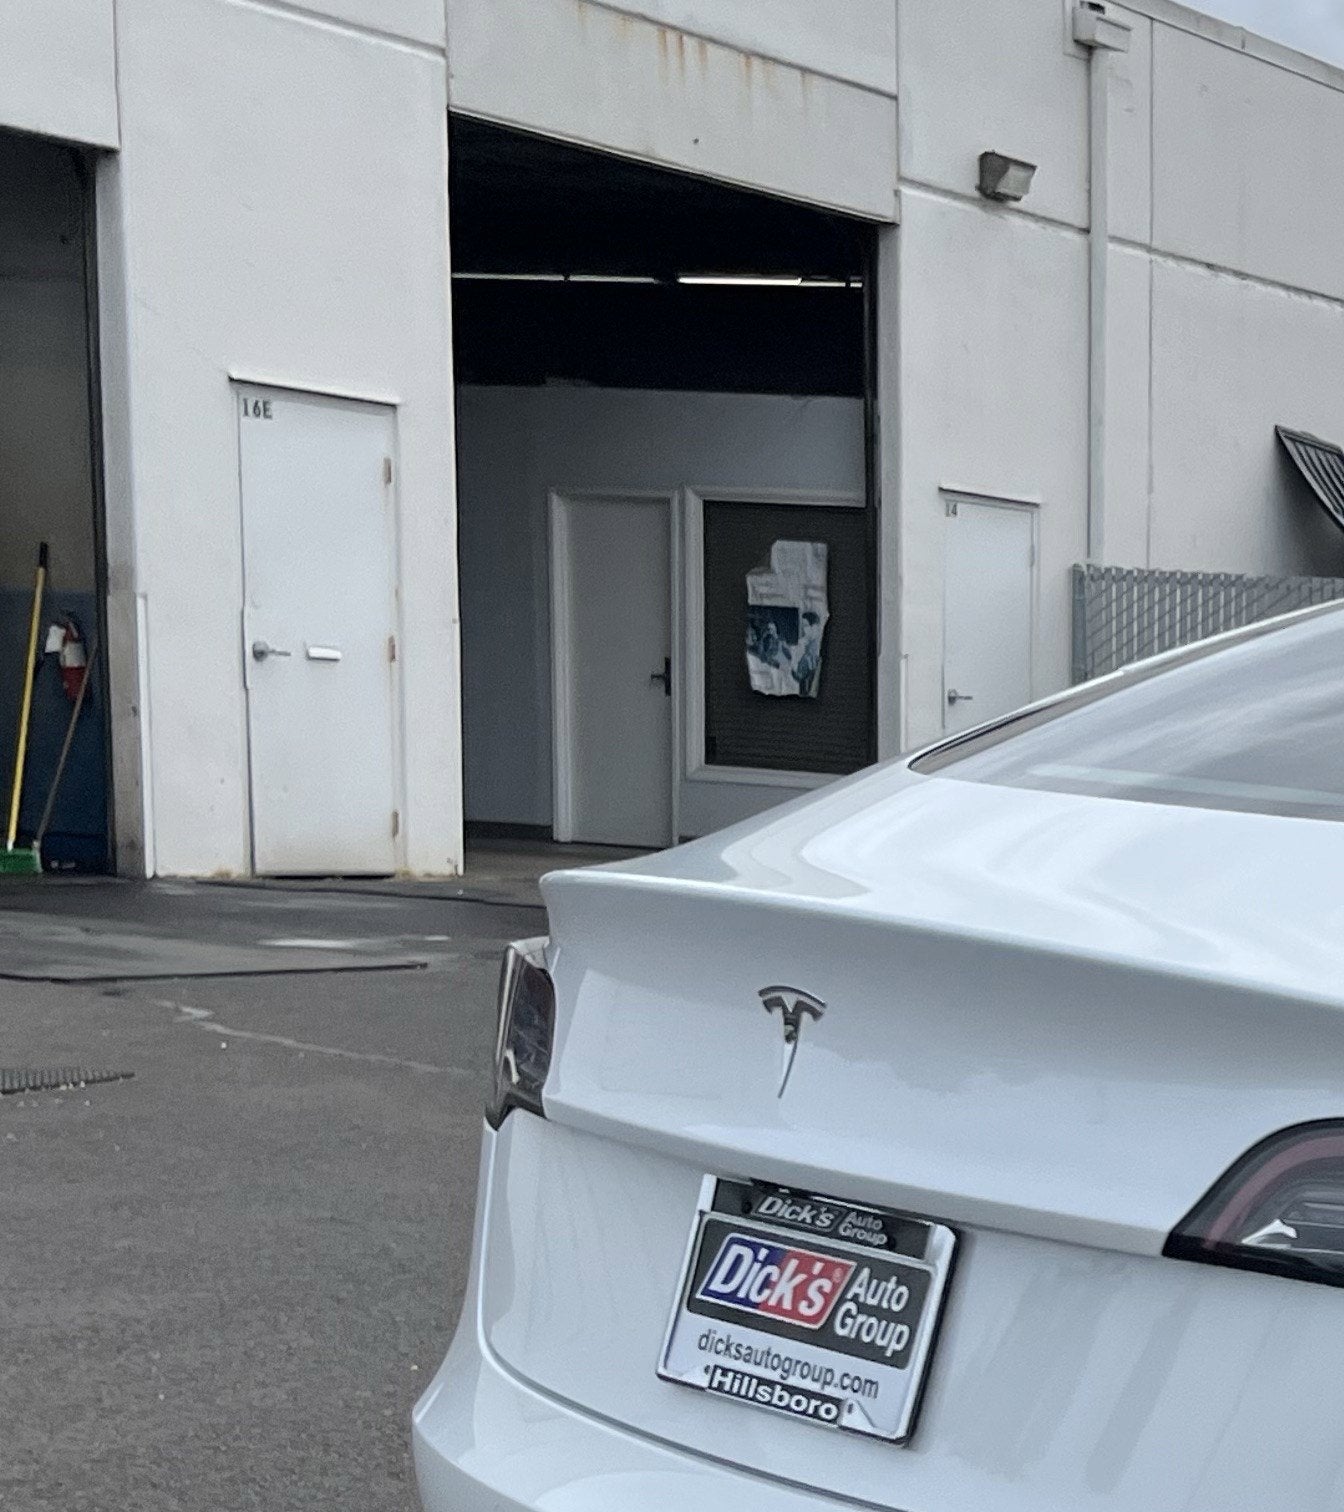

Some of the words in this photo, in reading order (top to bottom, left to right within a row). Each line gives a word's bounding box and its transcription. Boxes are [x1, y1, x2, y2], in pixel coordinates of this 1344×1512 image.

[242, 398, 273, 420] 16E
[758, 1196, 836, 1228] Dick's
[838, 1222, 889, 1247] Group
[846, 1211, 884, 1231] Auto
[708, 1244, 832, 1317] Dick's
[846, 1267, 910, 1312] Auto
[833, 1301, 911, 1357] Group
[697, 1329, 880, 1400] dicksautogroup.com
[710, 1370, 840, 1421] Hillsboro
